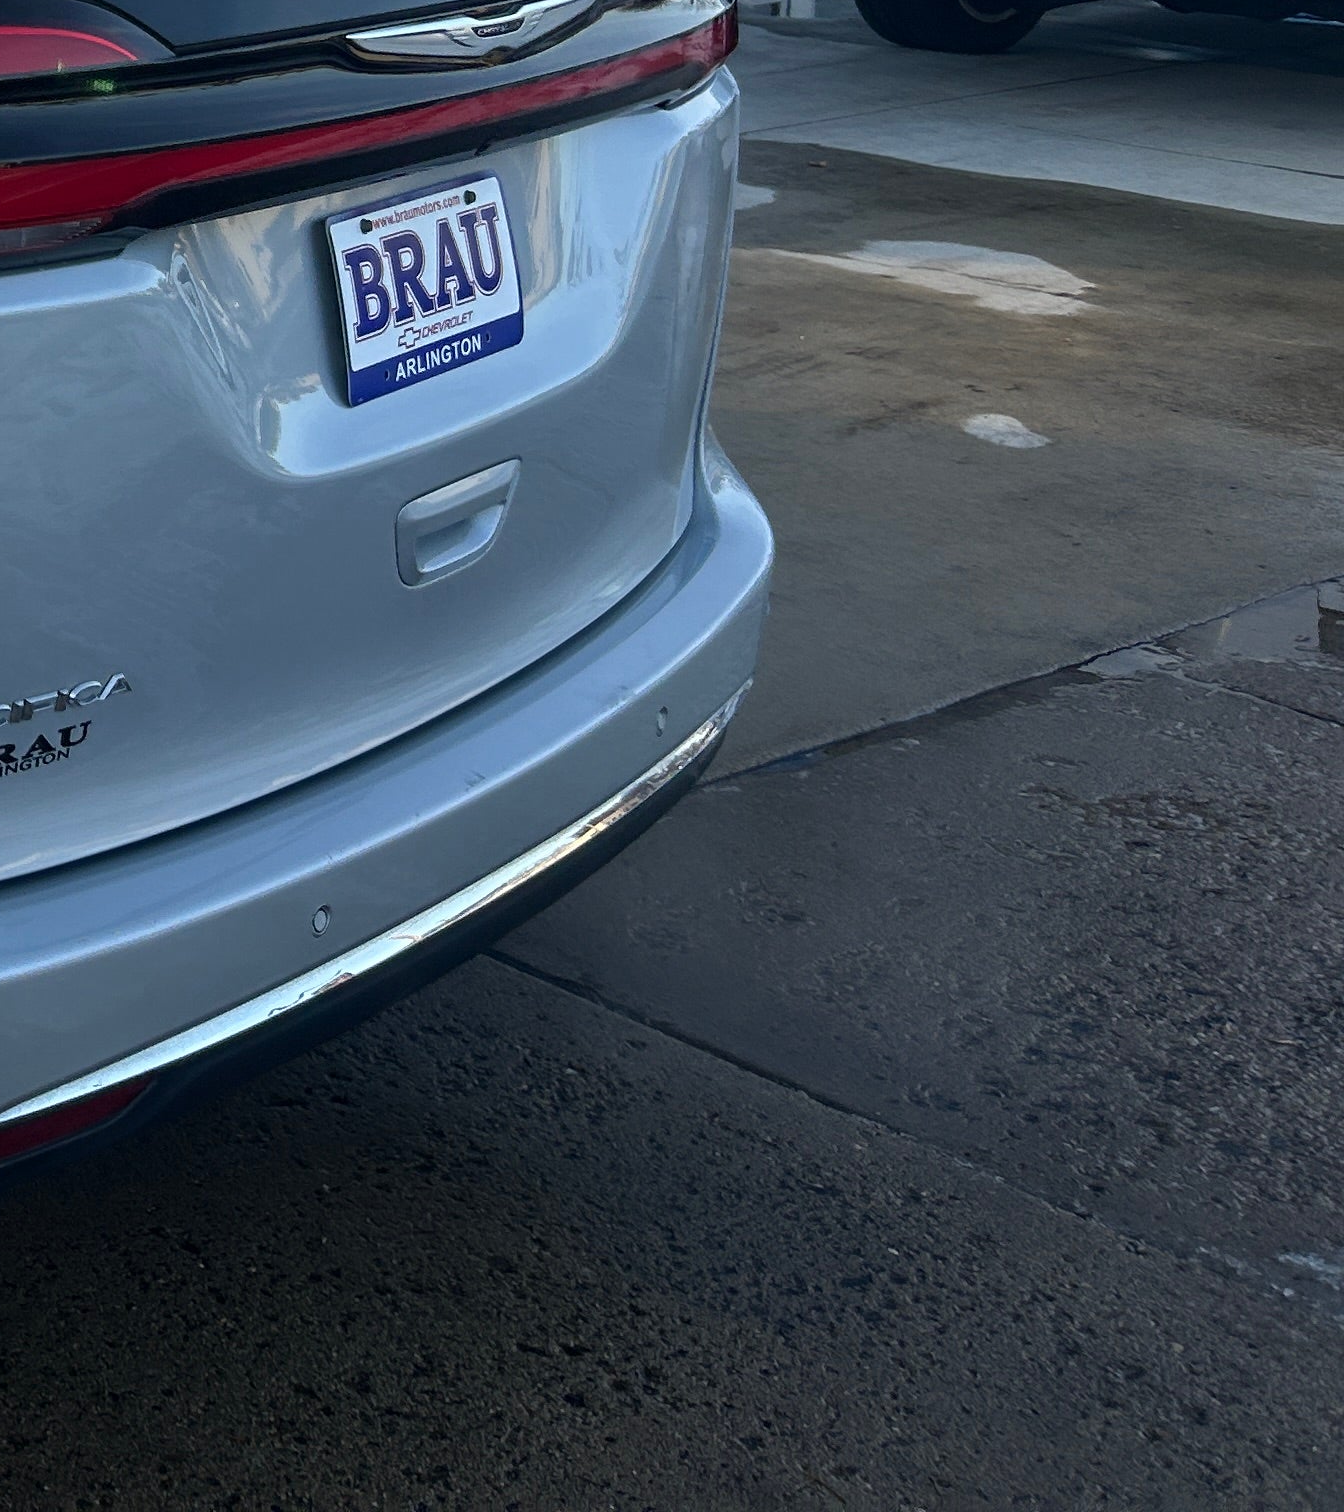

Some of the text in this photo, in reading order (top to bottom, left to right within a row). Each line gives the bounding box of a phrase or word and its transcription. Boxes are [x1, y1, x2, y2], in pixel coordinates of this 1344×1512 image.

[371, 195, 461, 230] www.braumotors.com
[342, 202, 504, 343] BRAU
[421, 310, 475, 339] CHEVROLET
[395, 334, 482, 382] ARLINGTON
